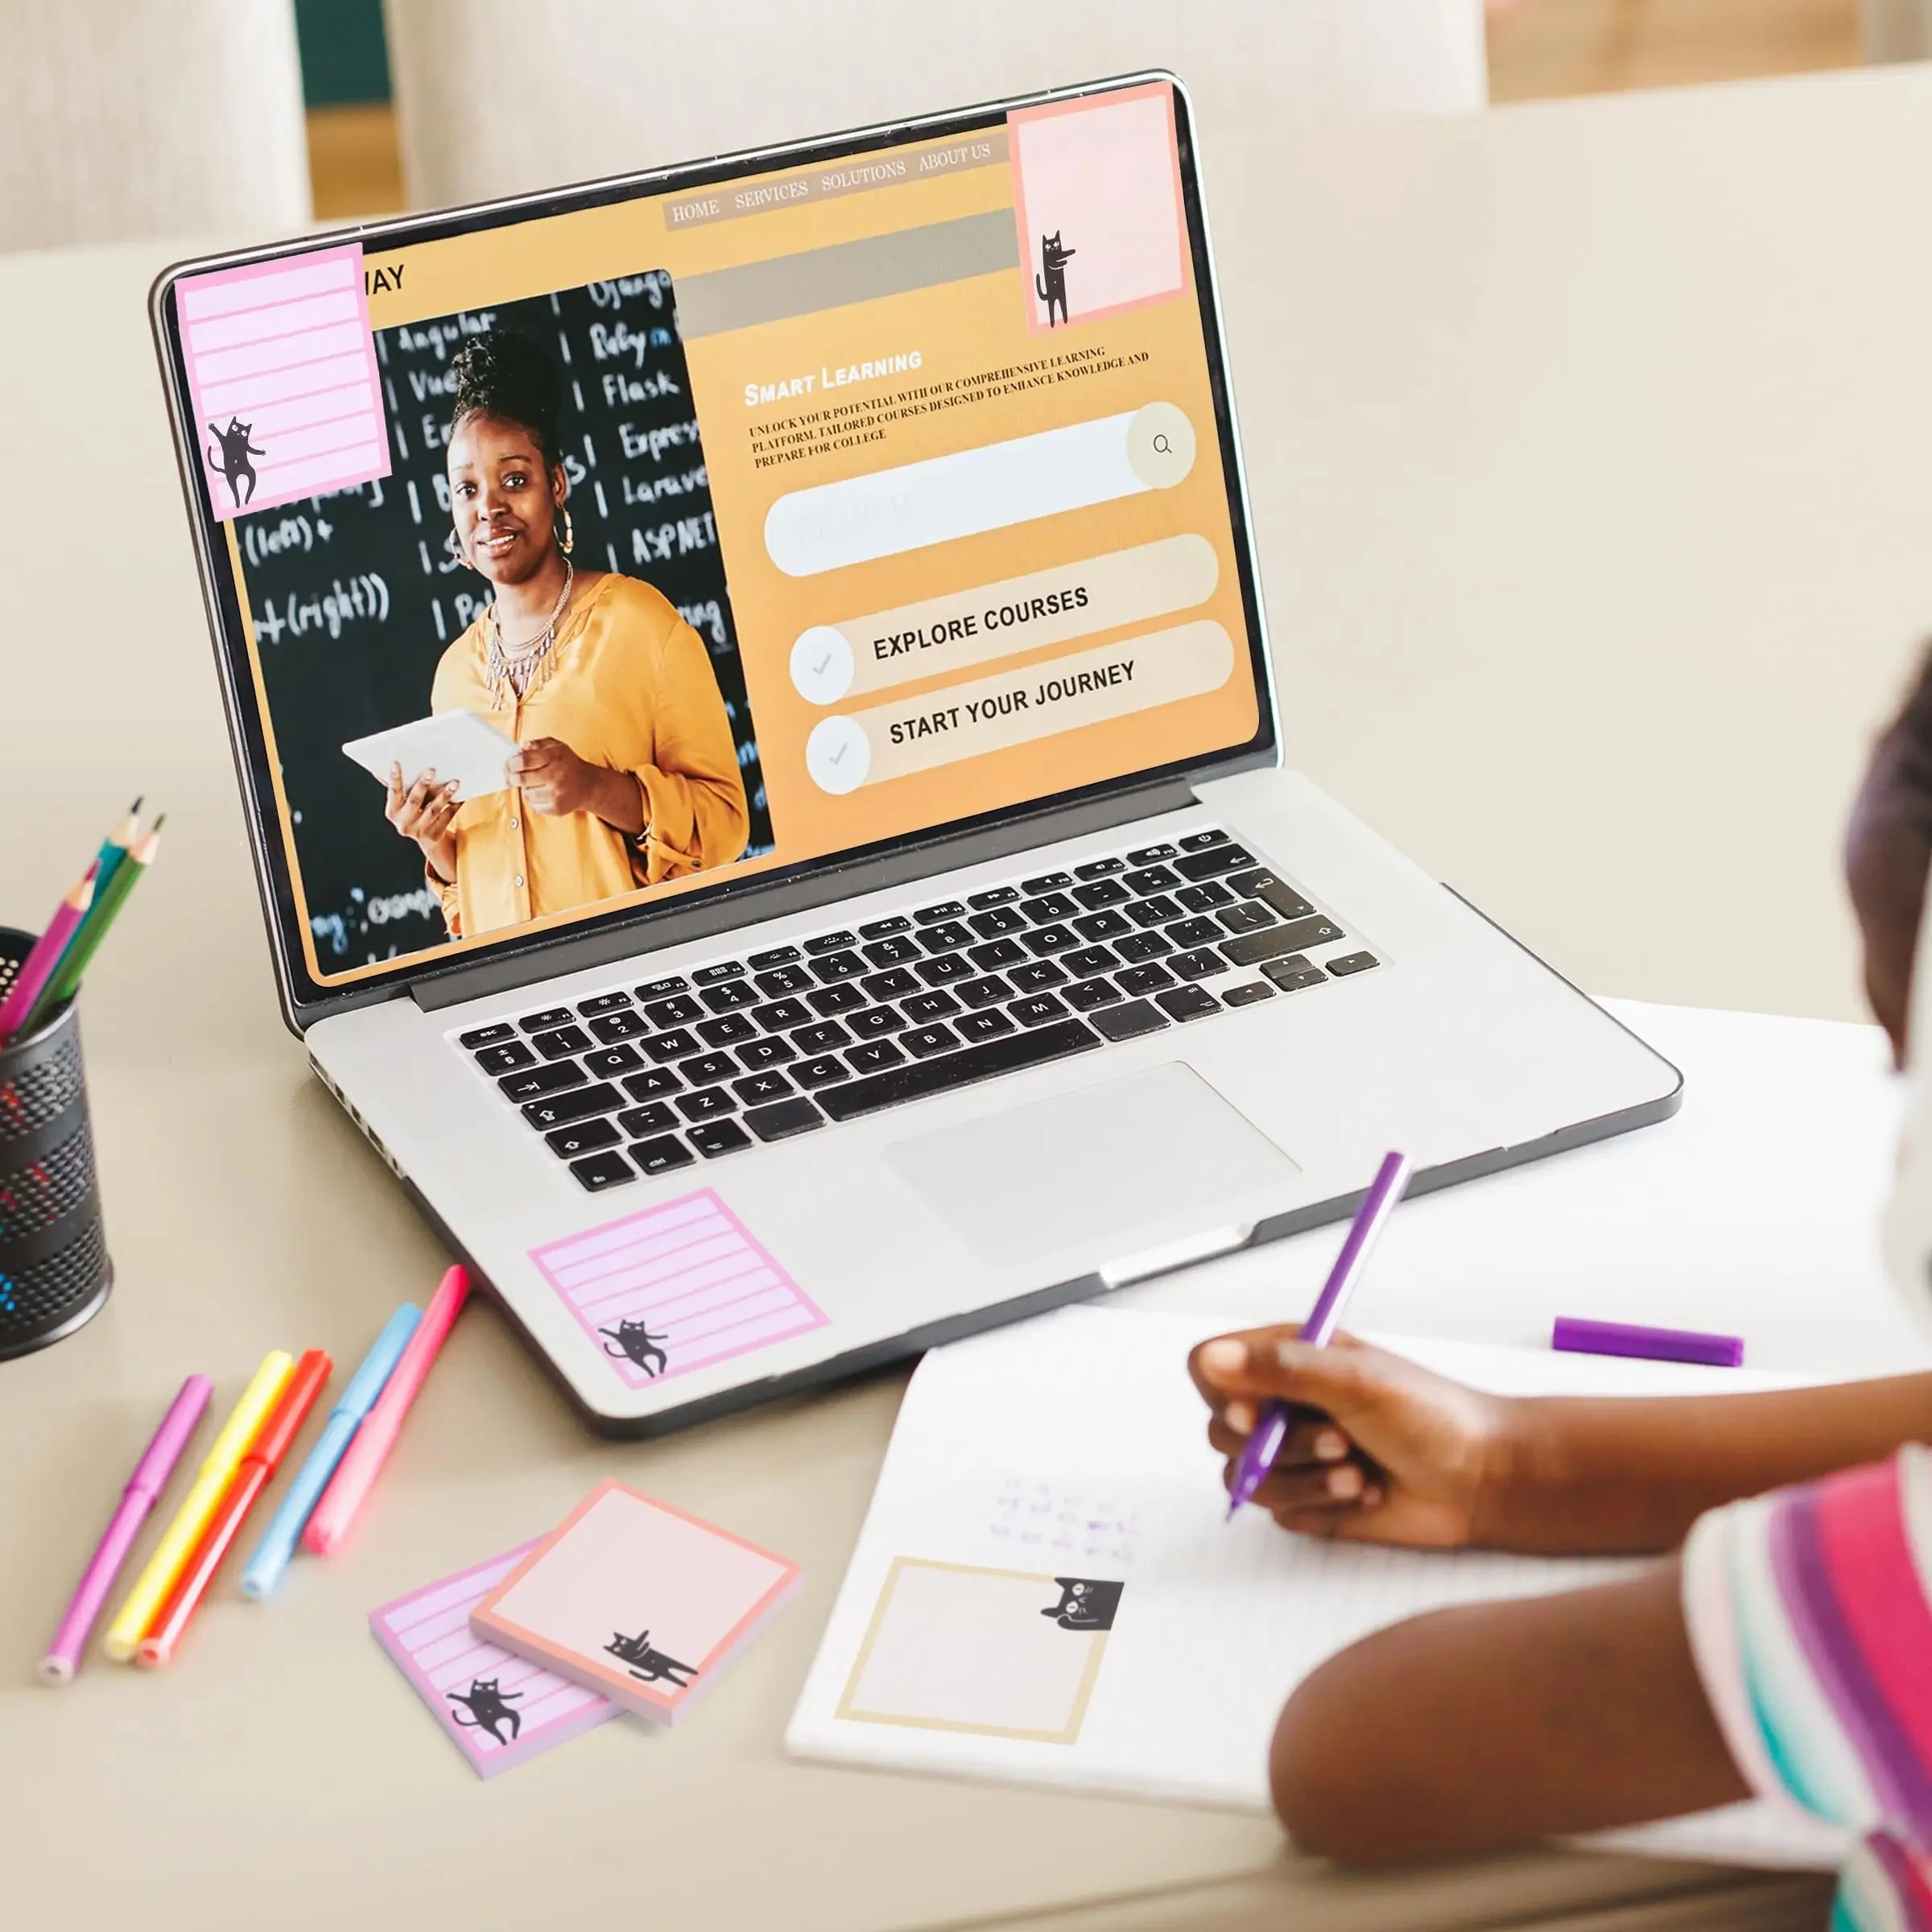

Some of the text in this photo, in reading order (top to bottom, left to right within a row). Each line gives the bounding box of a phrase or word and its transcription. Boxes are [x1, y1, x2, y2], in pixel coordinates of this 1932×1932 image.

[673, 143, 991, 222] HOME SERVICES SOLUTIONS ABOUT US
[365, 264, 404, 296] AY
[602, 369, 681, 408] Flask
[749, 346, 1106, 438] UNLOCK YOUR POTENTIAL WITH OUR COMPREHENSIVE LEARNING
[752, 350, 1150, 454] PLATFORM. TAILORED COURSES DESIGNED TO ENHANCE KNOWLEDGE AND
[755, 428, 887, 469] PREPARE FOR COLLEGE
[873, 586, 1089, 660] EXPLORE COURSES
[890, 660, 1135, 745] START YOUR JOURNEY
[607, 1055, 624, 1064] Q
[660, 1038, 679, 1050] W
[720, 1024, 733, 1034] E
[774, 1009, 790, 1018] R
[830, 993, 841, 1002] T
[884, 978, 896, 987] Y
[937, 963, 952, 972] U
[1096, 919, 1107, 929] P
[617, 1026, 630, 1034] 2
[673, 1010, 684, 1018] 3
[783, 980, 794, 989] 5
[838, 965, 848, 973] 6
[890, 950, 899, 958] 7
[944, 935, 956, 943] 8
[996, 921, 1006, 929] 9
[648, 956, 1098, 1088] A S D F G H J K L
[699, 1096, 714, 1108] Z
[756, 1080, 773, 1092] X
[812, 1065, 827, 1075] C
[867, 1050, 880, 1059] V
[923, 1034, 937, 1044] B
[976, 1018, 993, 1029] N
[1031, 1003, 1049, 1013] M
